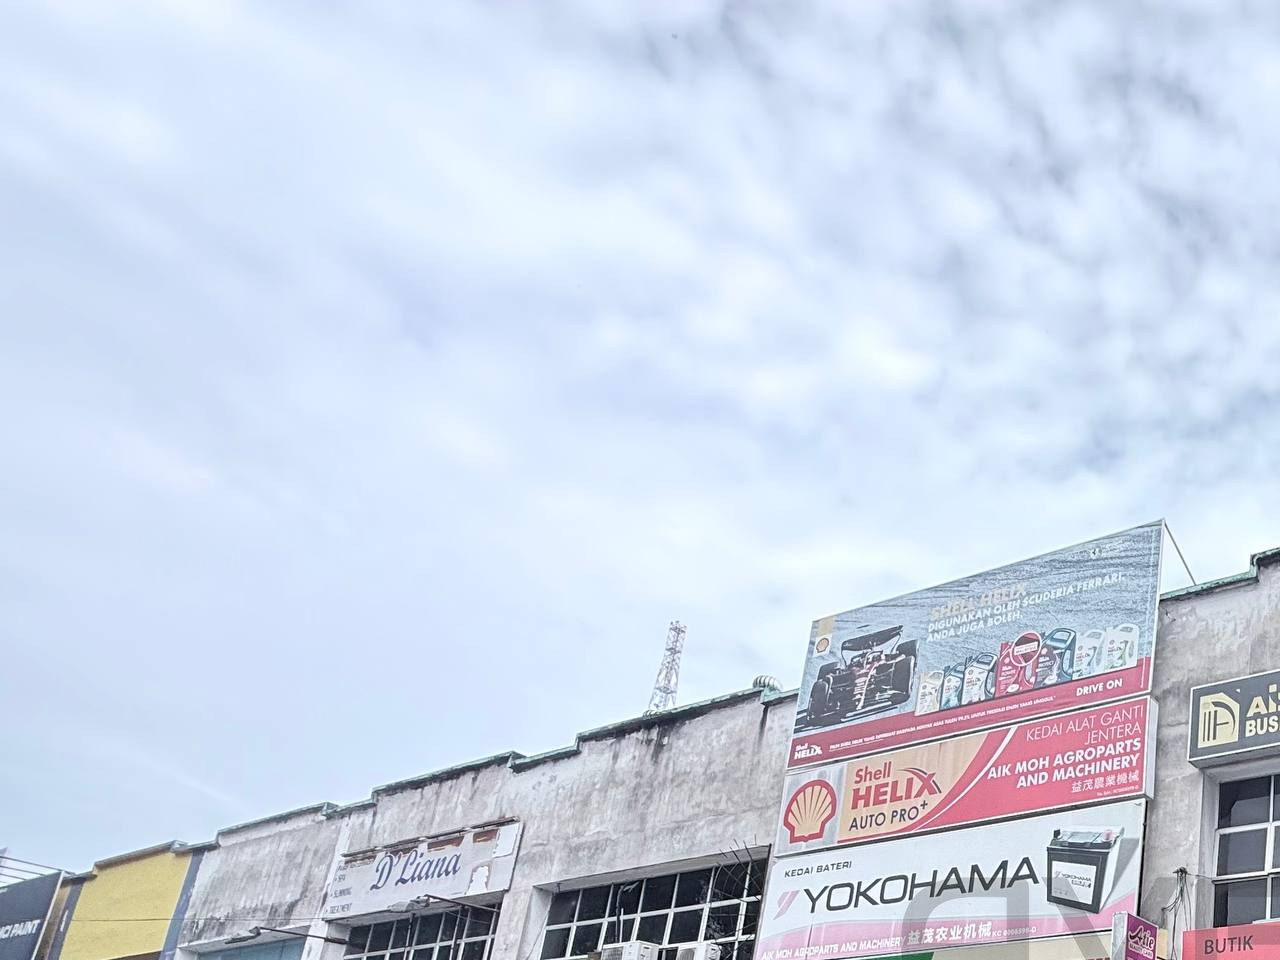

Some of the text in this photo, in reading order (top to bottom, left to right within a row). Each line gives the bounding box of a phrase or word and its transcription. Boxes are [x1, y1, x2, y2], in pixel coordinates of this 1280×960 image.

[928, 573, 1126, 632] DIGUNAKAN OLEH SCUDERIA FERRARI.
[926, 611, 1023, 643] ANDA JUGA BOLEH.
[1076, 678, 1123, 697] DRIVE ON
[1026, 705, 1144, 741] KEDAI ALAT GANTI
[1085, 722, 1142, 745] JENTERA
[987, 737, 1142, 780] AIK MOH AGROPARTS
[1016, 753, 1140, 789] AND MACHINERY
[854, 761, 892, 784] Shell
[851, 769, 941, 810] HELIX
[849, 812, 886, 832] AUTO
[784, 861, 852, 878] KEDAI BATERI
[803, 857, 1040, 914] YOKOHAMA
[11, 919, 41, 936] PAINT
[762, 935, 905, 960] AIK MOH AGROPARTS AND MACHINERY
[1204, 935, 1254, 955] BUTIK
